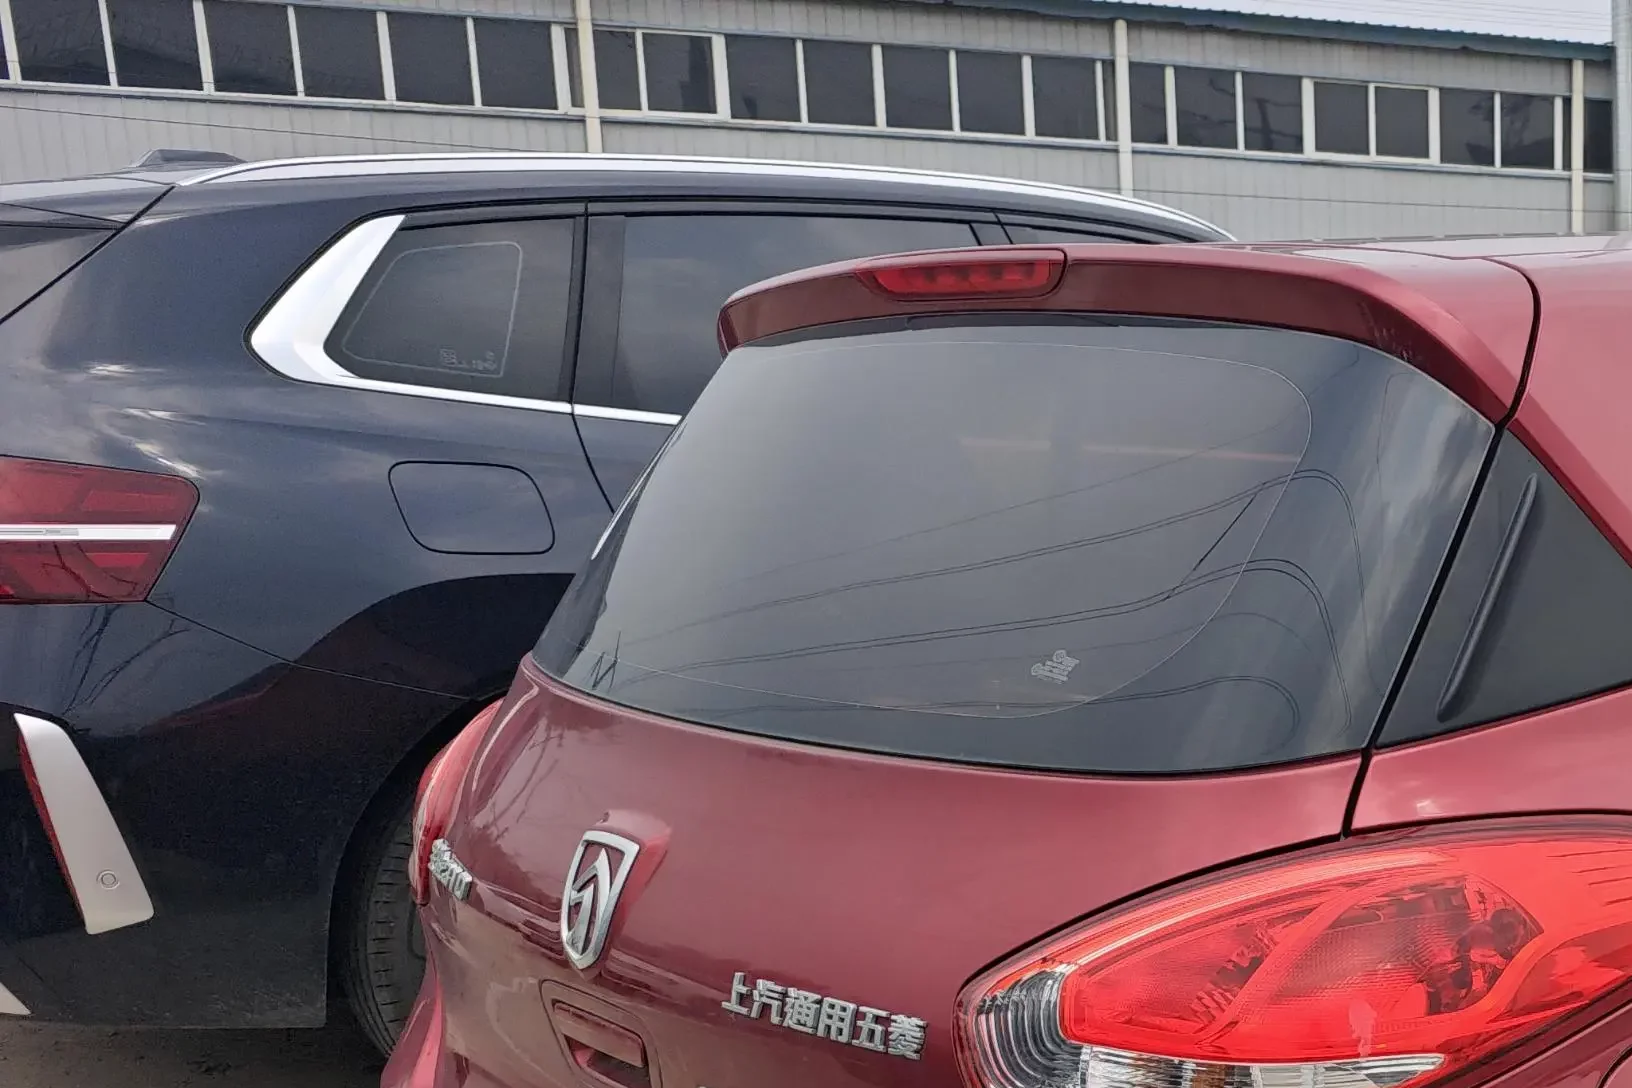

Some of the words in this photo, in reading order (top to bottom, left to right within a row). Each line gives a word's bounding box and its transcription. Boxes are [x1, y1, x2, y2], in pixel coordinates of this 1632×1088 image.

[721, 971, 928, 1061] 上汽通用五菱
